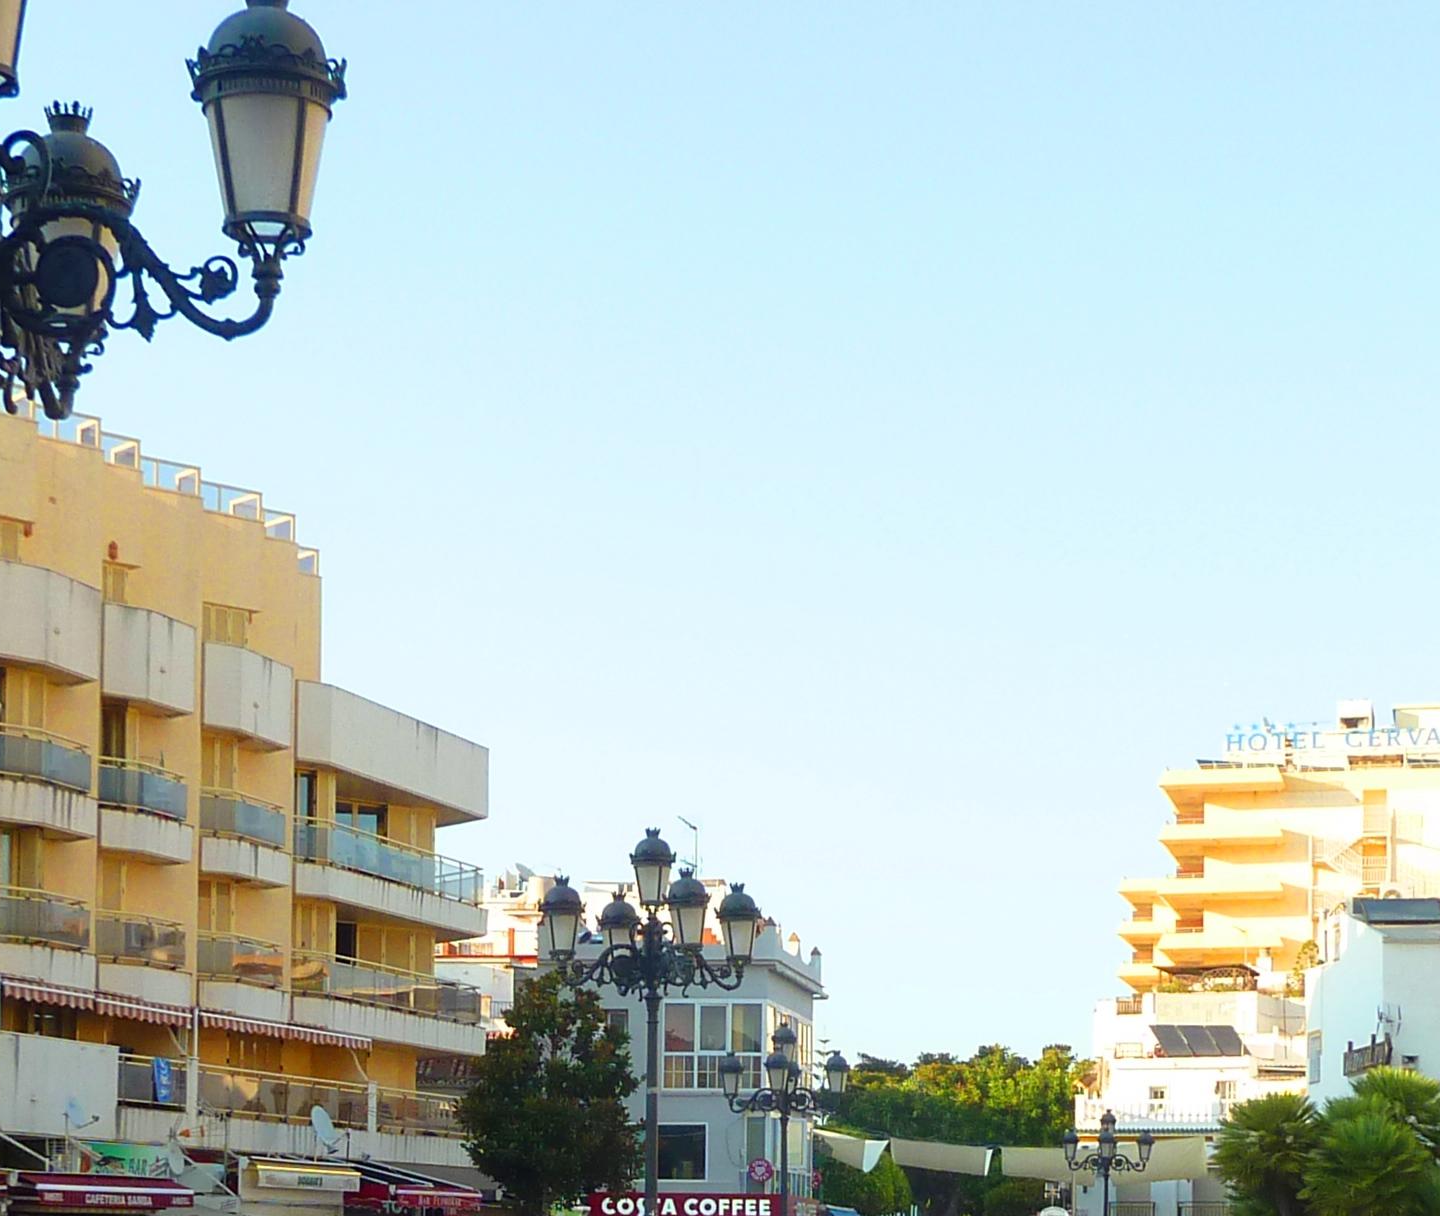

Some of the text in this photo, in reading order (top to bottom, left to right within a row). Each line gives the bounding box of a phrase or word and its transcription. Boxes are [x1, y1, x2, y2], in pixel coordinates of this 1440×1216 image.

[1226, 731, 1325, 752] HOTEL
[601, 1198, 678, 1216] COSA
[684, 1198, 772, 1216] COFFEE
